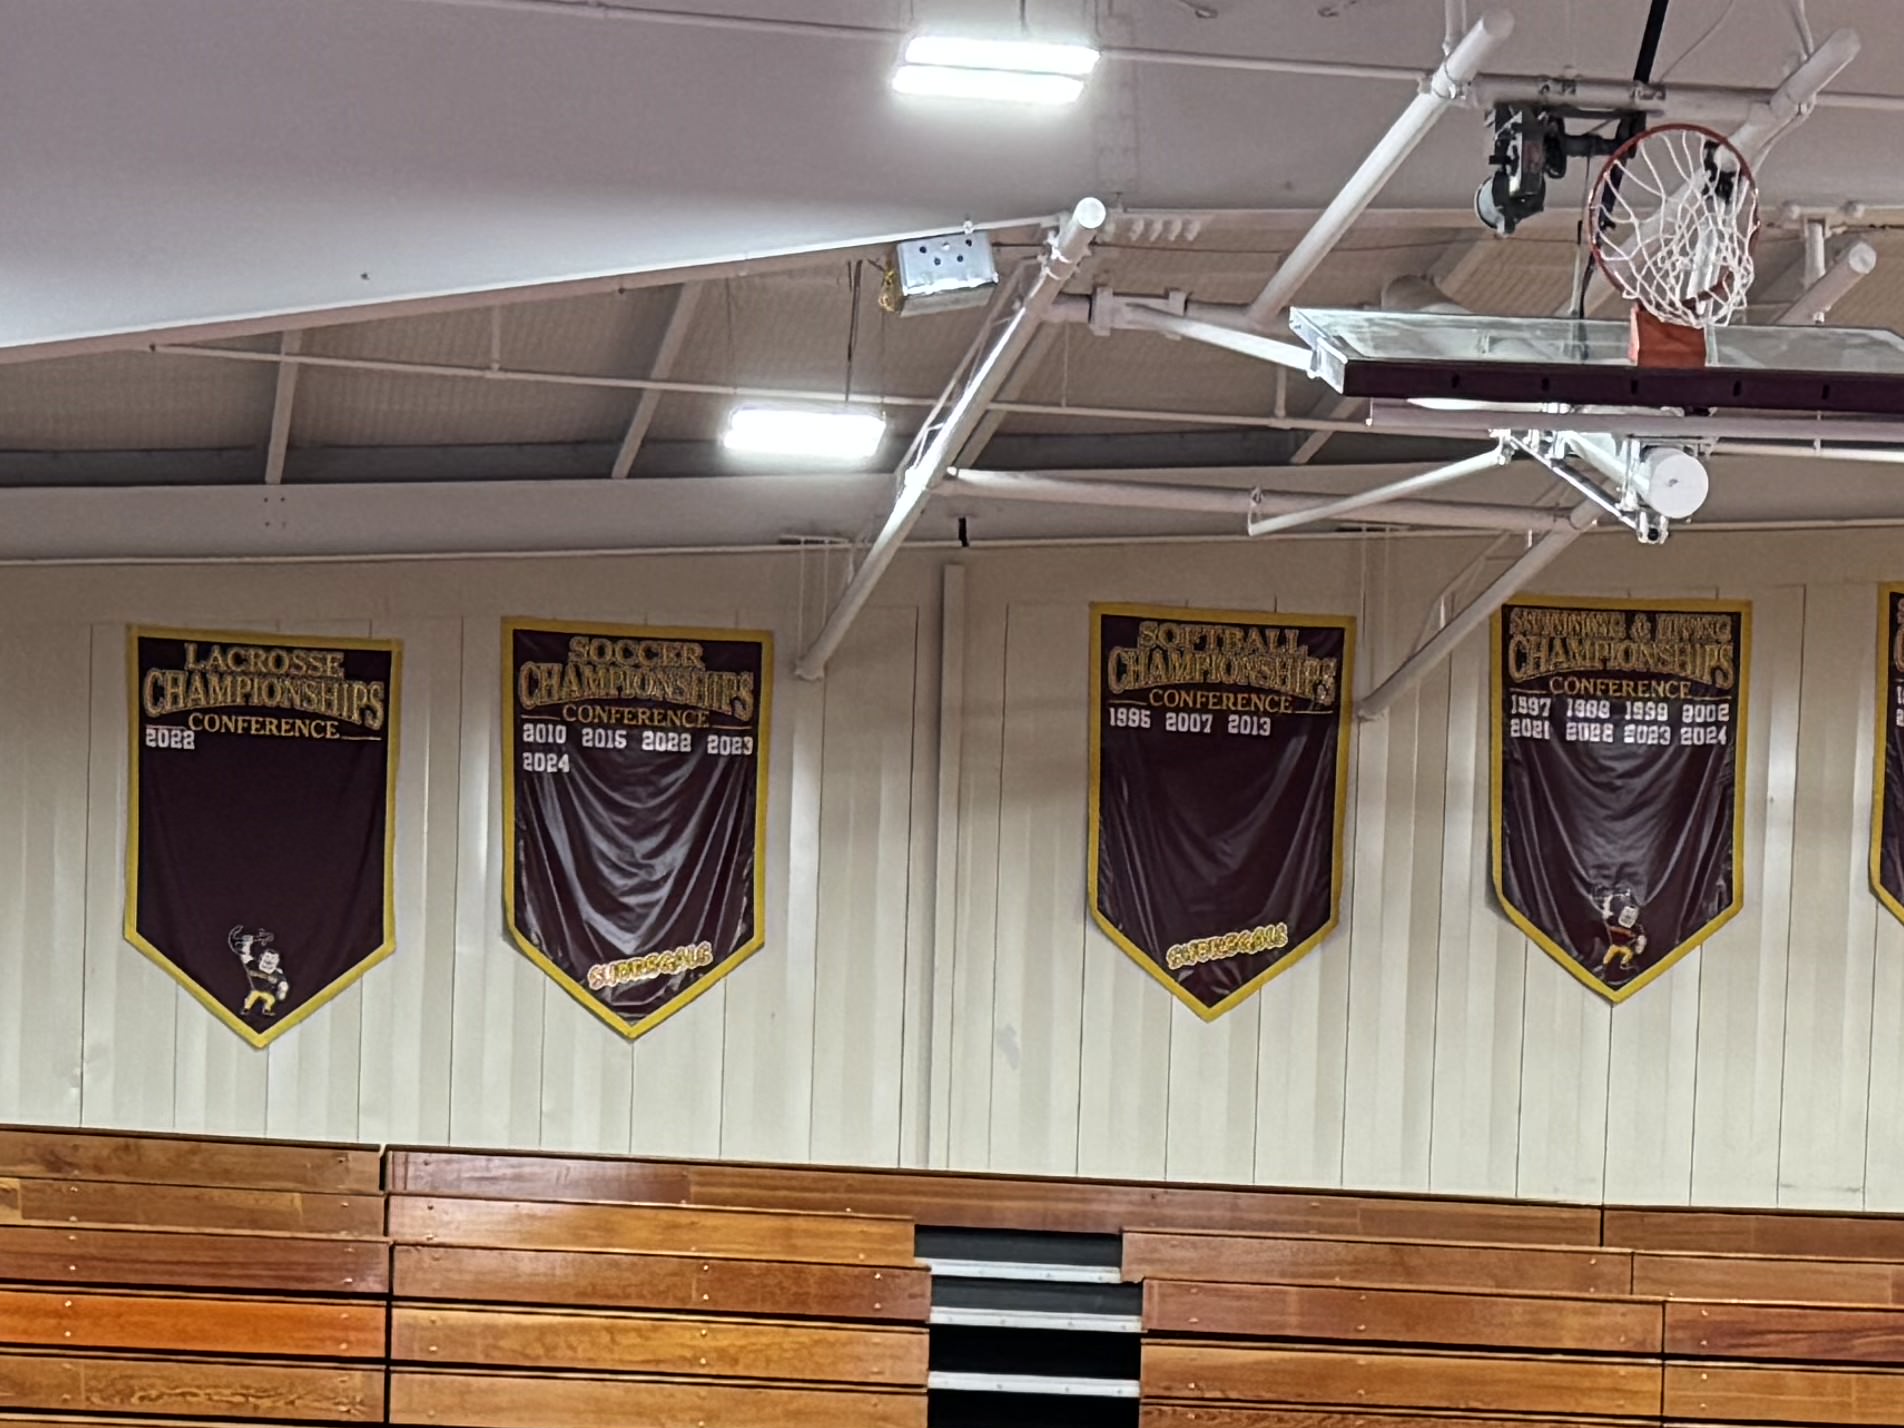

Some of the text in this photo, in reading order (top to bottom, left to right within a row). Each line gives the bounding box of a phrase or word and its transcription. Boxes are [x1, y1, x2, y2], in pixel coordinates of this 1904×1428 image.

[568, 636, 705, 670] SOCCER
[1138, 621, 1308, 654] SOFTBALL
[184, 643, 345, 678] LACROSSE
[1108, 646, 1337, 706] CHAMPIONSHIPS
[1508, 635, 1734, 690] CHAMPIONSHIPS
[144, 667, 385, 731] CHAMPIONSHIPS
[520, 661, 754, 722] CHAMPIONSHIPS
[1149, 689, 1293, 714] CONFERENCE
[1550, 676, 1692, 699] CONFERENCE
[188, 712, 340, 740] CONFERENCE
[562, 703, 710, 728] CONFERENCE
[1166, 712, 1213, 734] 2007
[1227, 714, 1271, 736] 2013
[146, 728, 195, 750] 2022
[523, 723, 754, 756] 2010 2015 2022 2023
[523, 752, 570, 773] 2024
